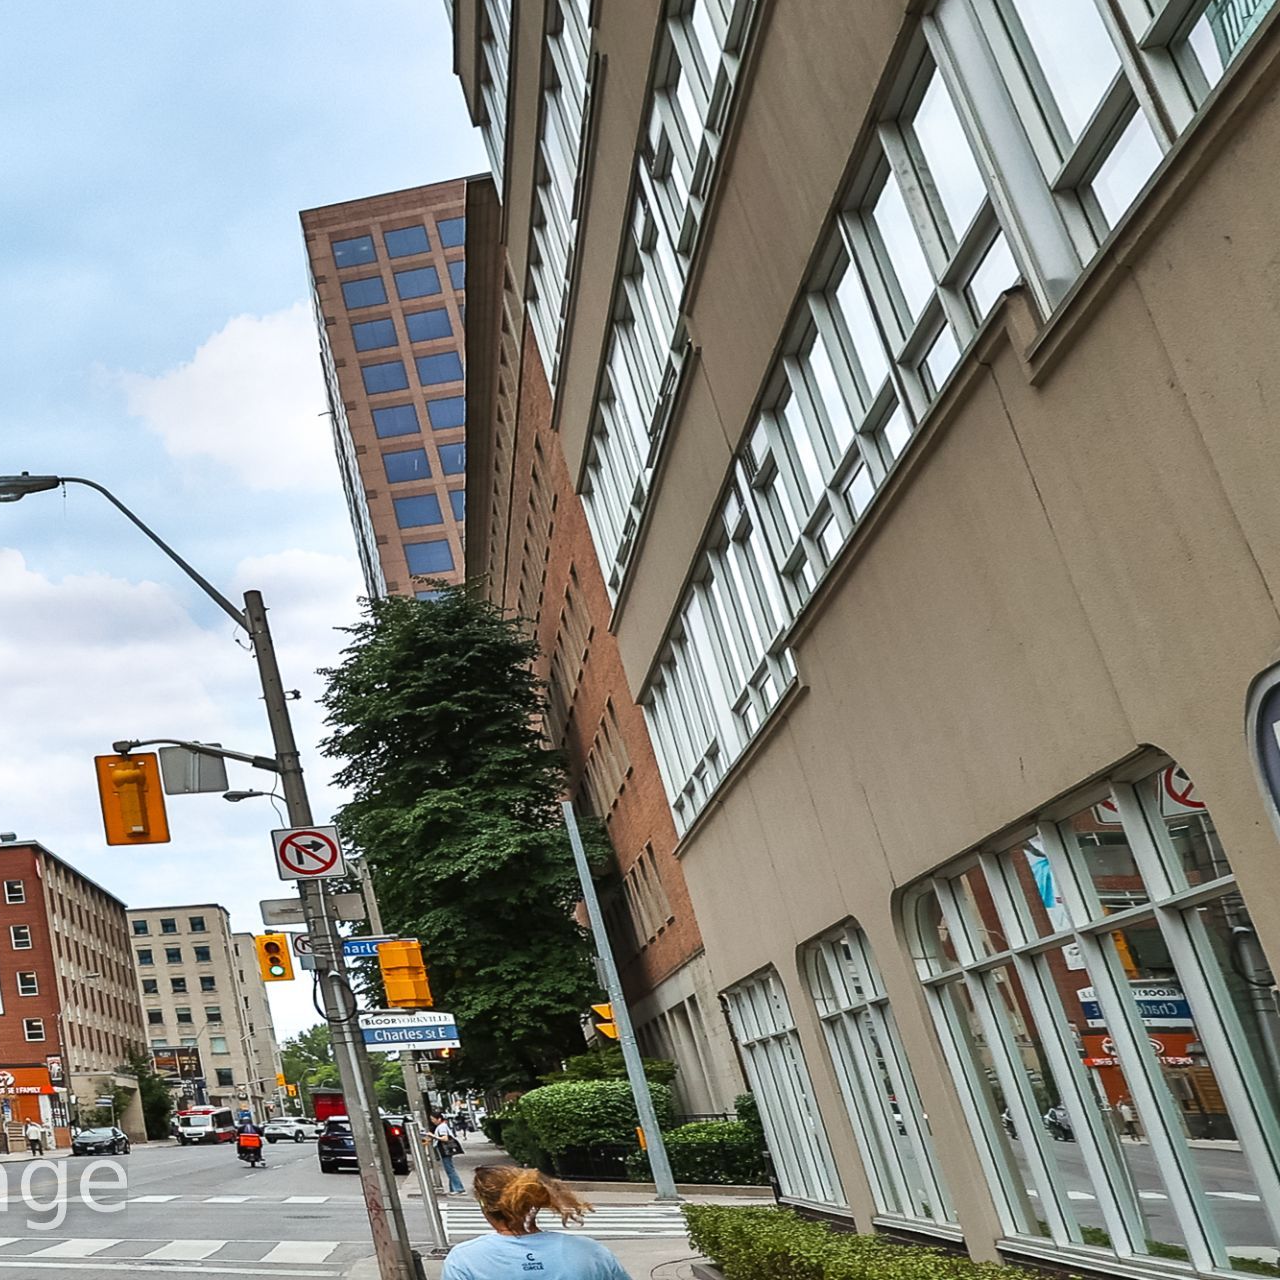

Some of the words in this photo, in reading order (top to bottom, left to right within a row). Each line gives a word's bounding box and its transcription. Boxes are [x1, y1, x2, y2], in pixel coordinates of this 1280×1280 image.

[374, 1029, 423, 1041] Charles
[425, 1030, 436, 1039] St
[438, 1027, 447, 1038] E
[20, 1086, 41, 1095] FAMILY
